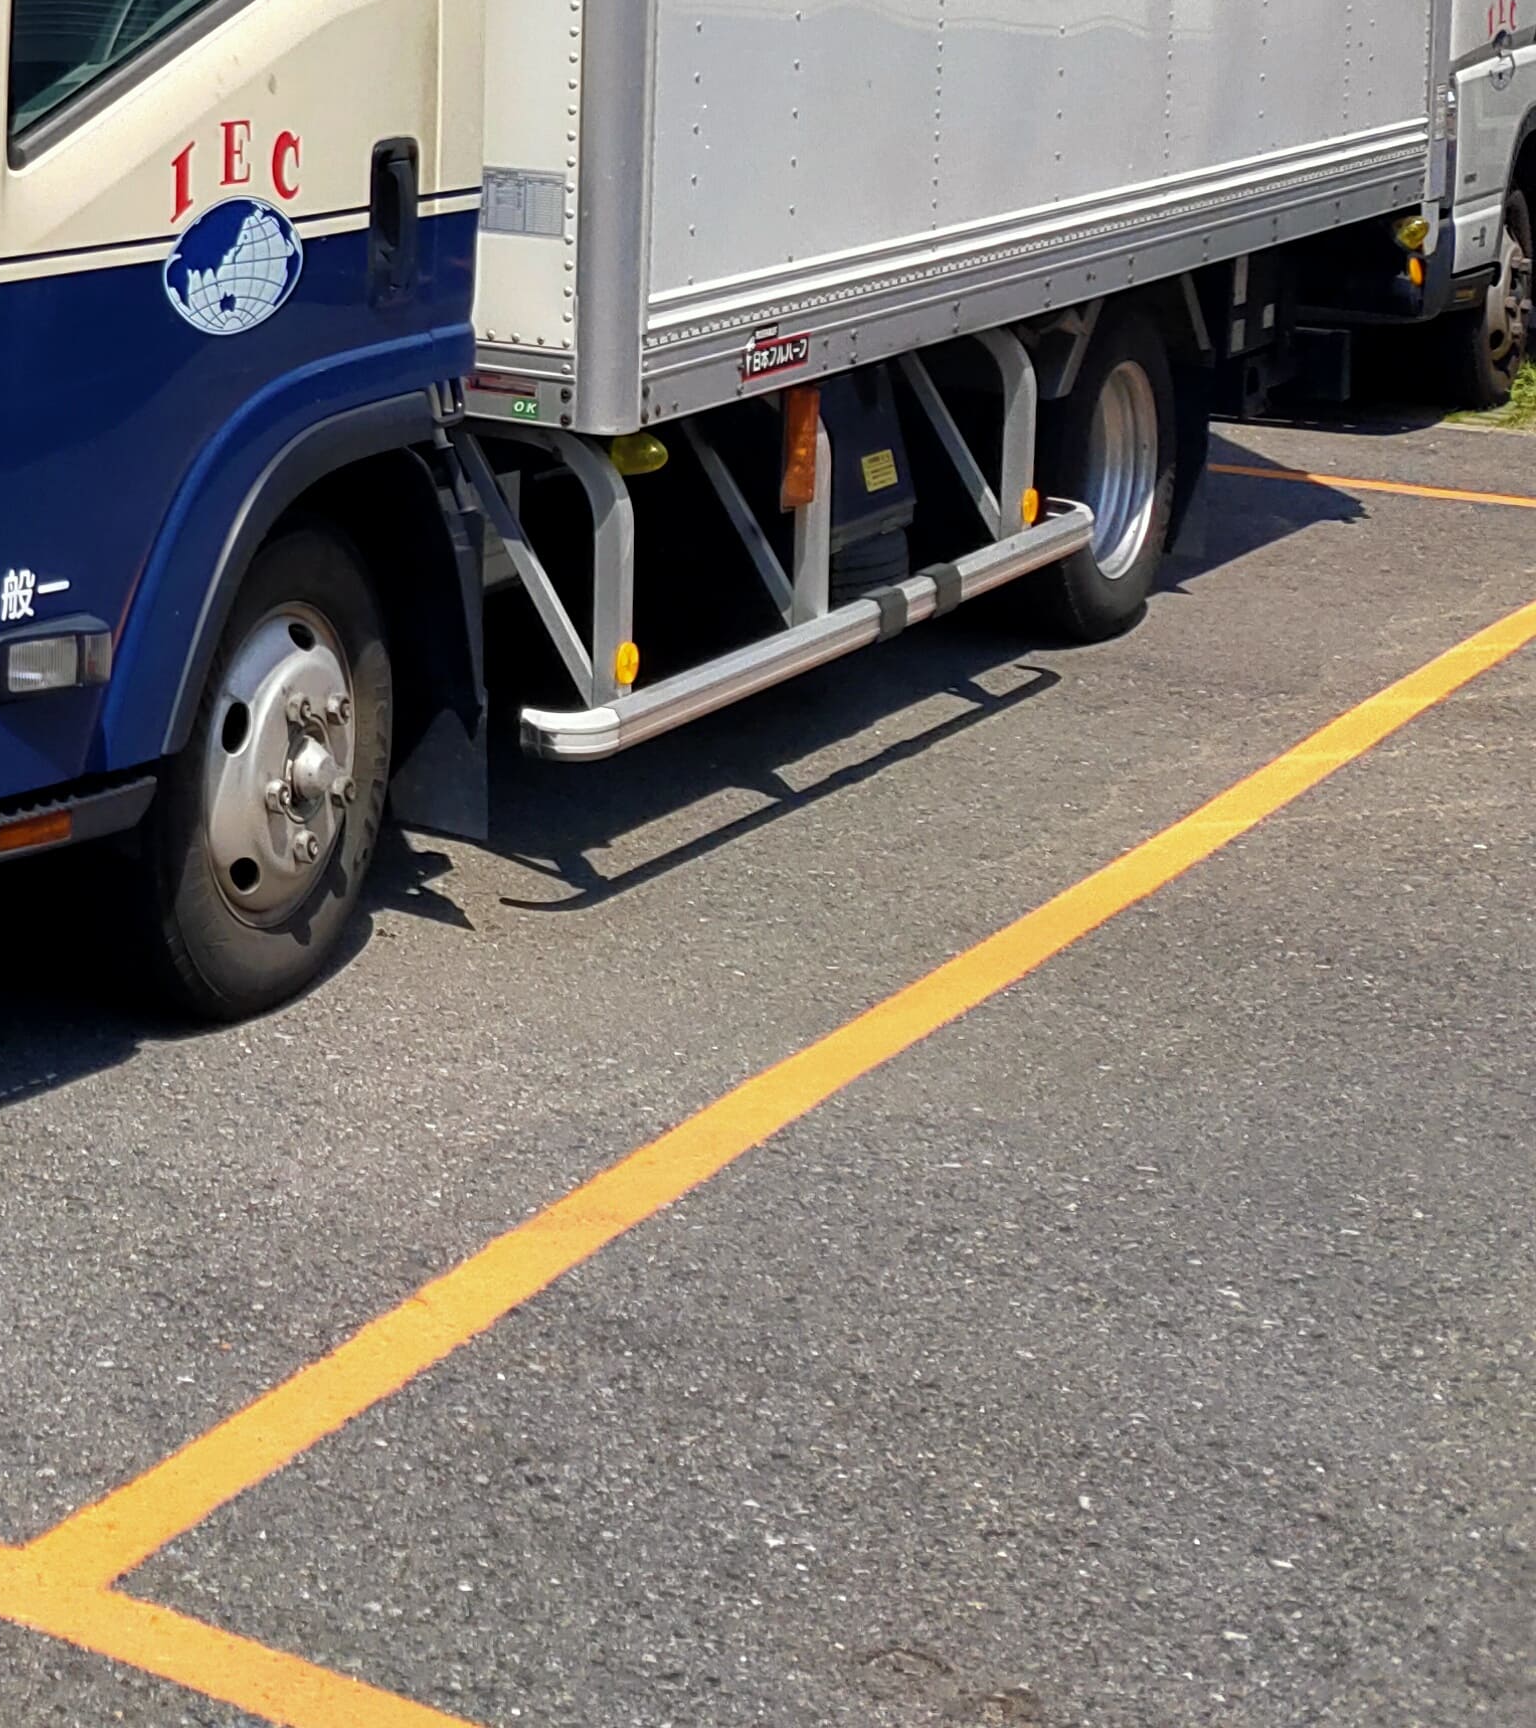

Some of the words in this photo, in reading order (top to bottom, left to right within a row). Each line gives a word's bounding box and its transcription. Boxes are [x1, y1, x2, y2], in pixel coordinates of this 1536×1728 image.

[170, 120, 300, 223] IEC
[753, 338, 807, 372] 日本フルハーフ
[514, 400, 537, 414] OK
